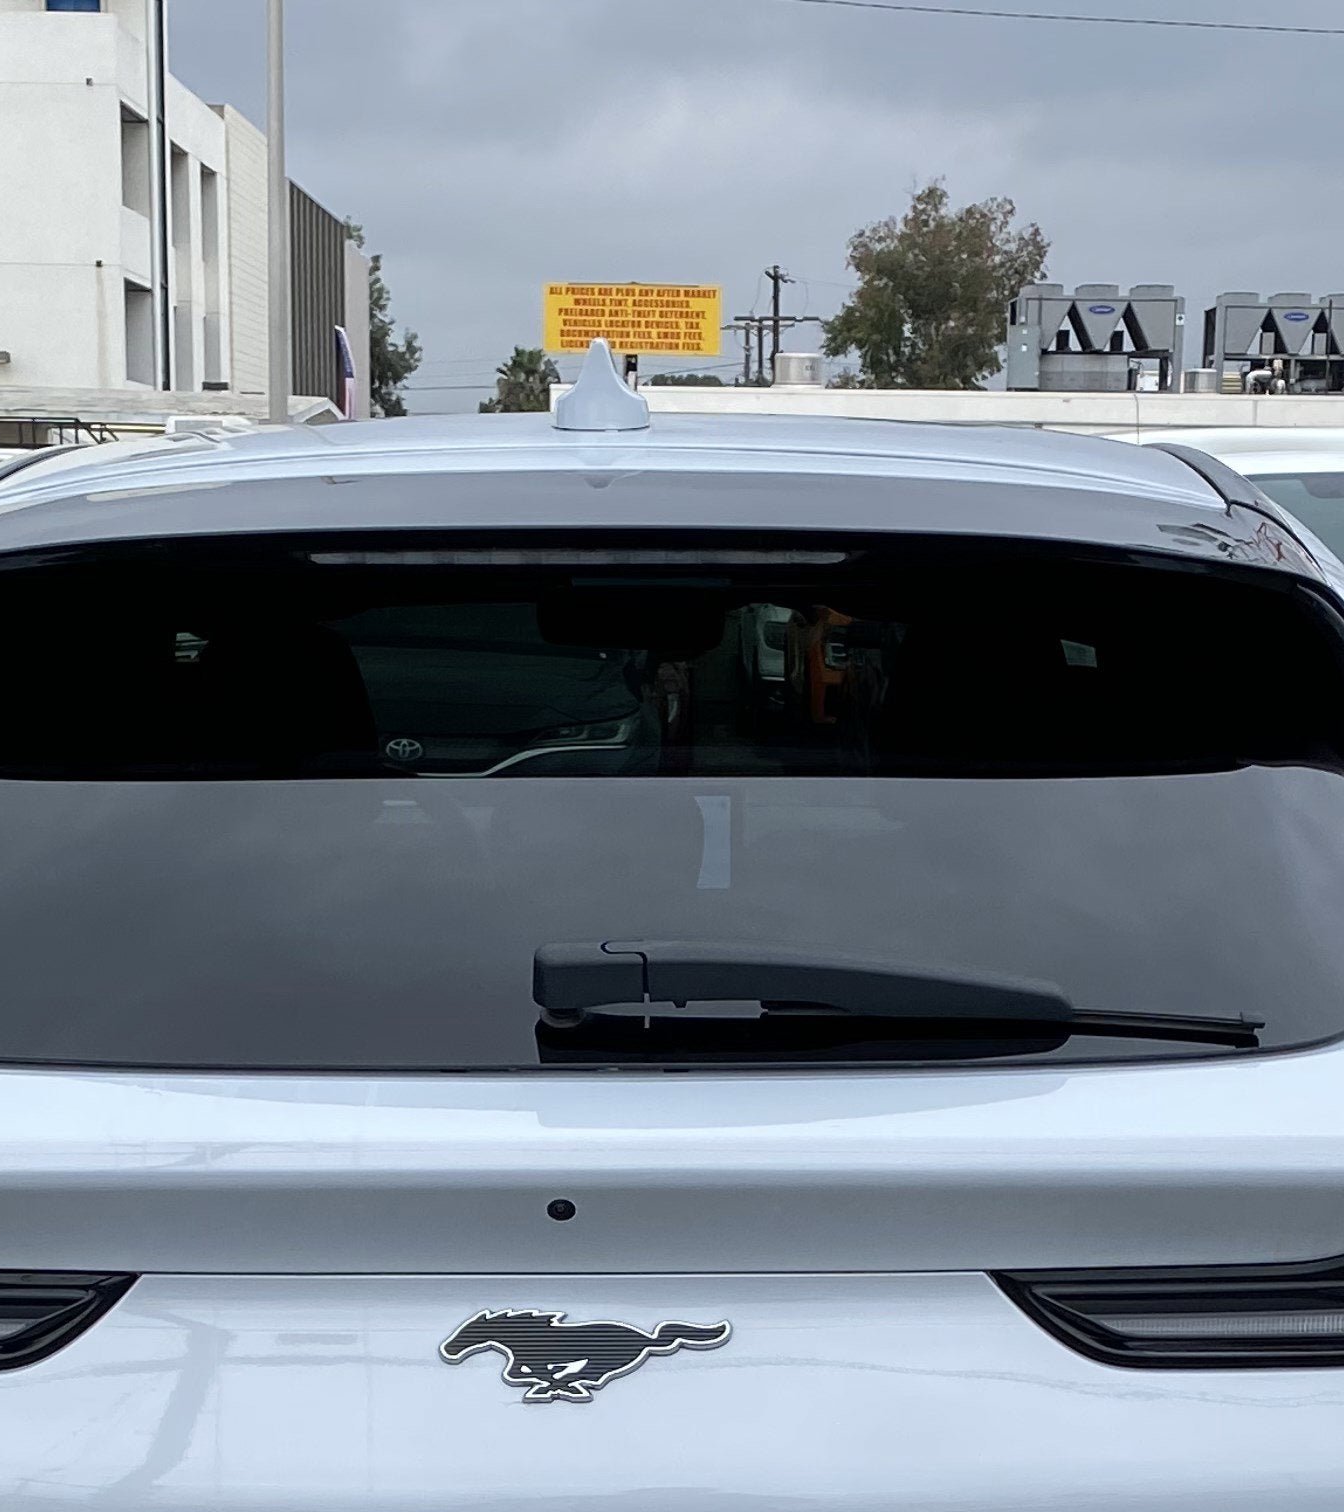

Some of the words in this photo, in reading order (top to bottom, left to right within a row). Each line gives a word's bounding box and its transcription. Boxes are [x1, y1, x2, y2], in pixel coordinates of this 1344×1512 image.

[549, 286, 563, 295] ALL
[565, 287, 595, 296] PRICES
[597, 287, 613, 297] ARE
[615, 288, 636, 297] PLUS
[638, 288, 654, 297] ANY
[656, 289, 681, 298] AFTER
[683, 289, 717, 299] MARKET
[604, 319, 642, 329] LOCATOR
[618, 341, 680, 350] REGISTRATION
